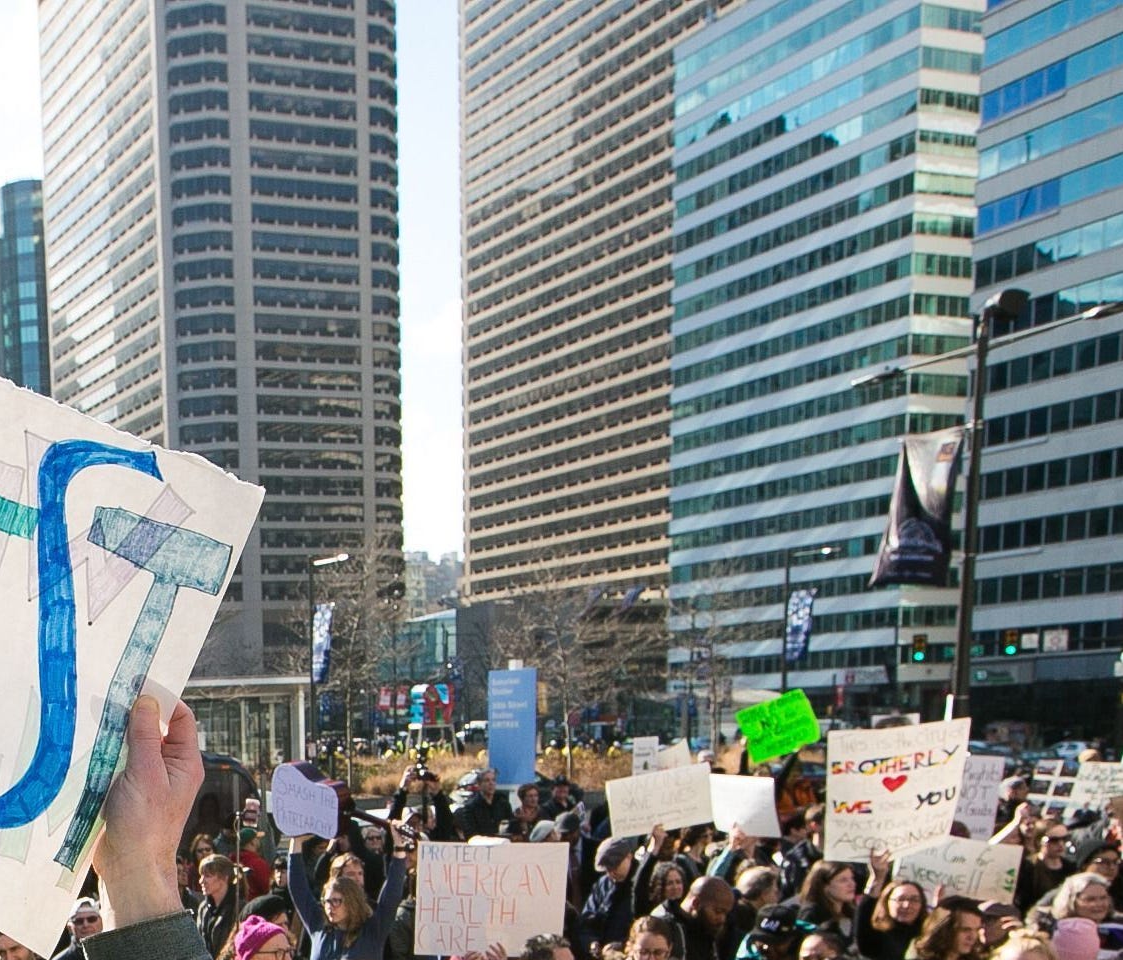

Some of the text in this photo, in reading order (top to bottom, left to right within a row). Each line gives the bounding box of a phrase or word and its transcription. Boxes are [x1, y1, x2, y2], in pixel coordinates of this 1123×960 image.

[831, 744, 960, 776] BROTHERLY
[833, 799, 873, 814] WE
[915, 786, 956, 810] YOU
[421, 846, 493, 863] PROTECT
[423, 864, 551, 897] AMERICAN
[418, 897, 517, 926] HEALTH
[418, 926, 479, 951] CARE
